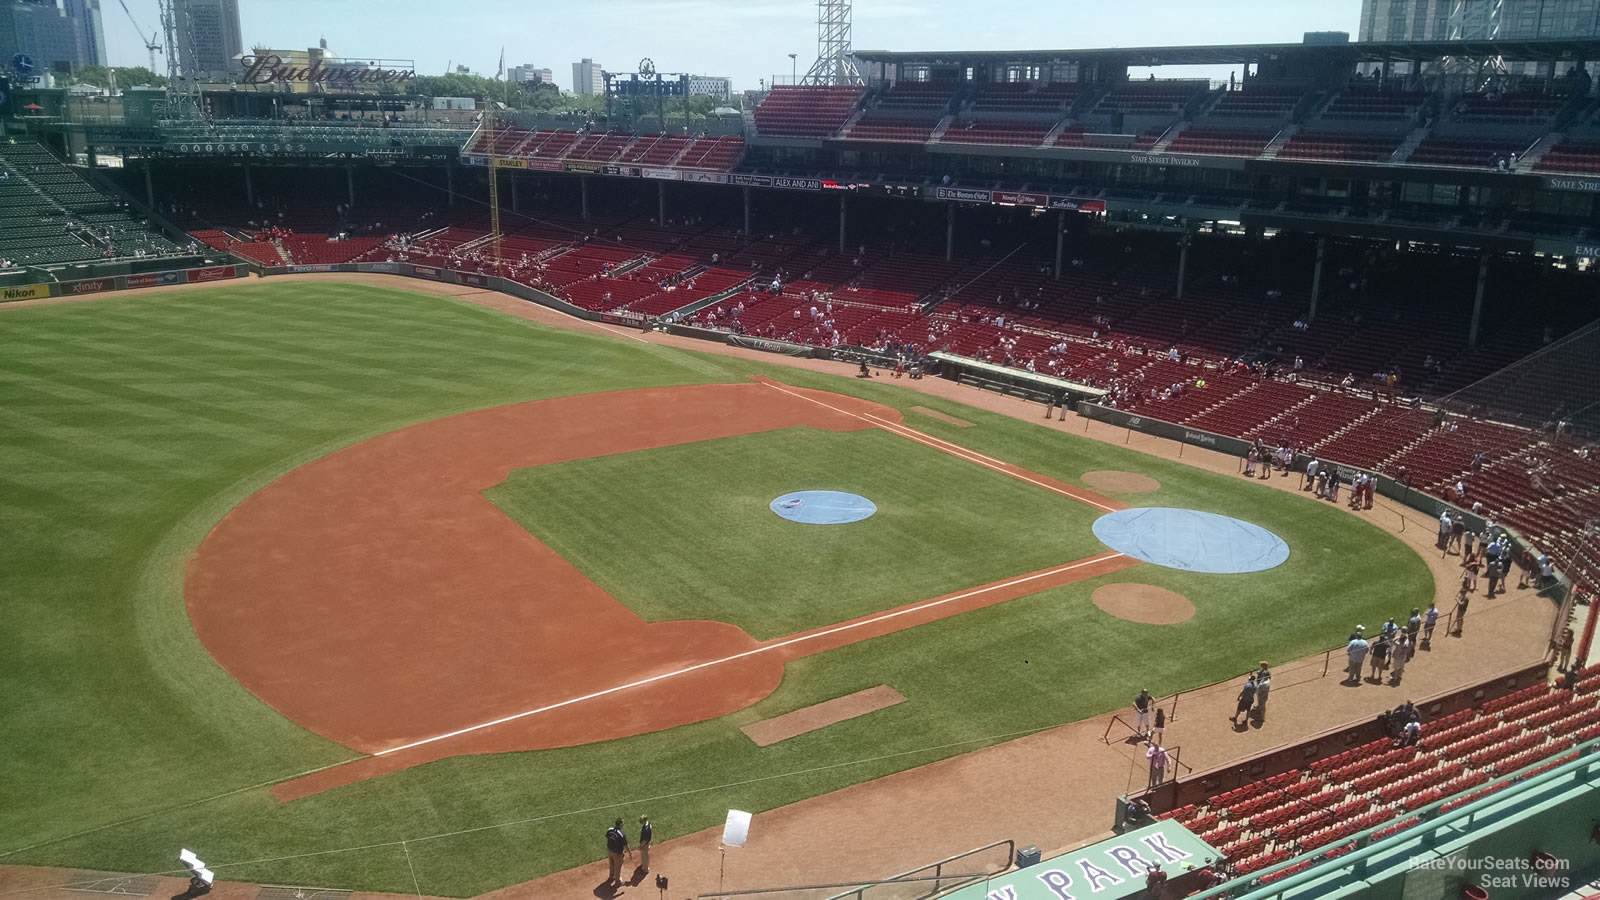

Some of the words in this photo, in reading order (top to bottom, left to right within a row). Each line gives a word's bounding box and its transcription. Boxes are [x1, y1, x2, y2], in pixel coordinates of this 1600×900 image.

[241, 55, 416, 89] Budweiser
[1131, 155, 1147, 163] STATE
[1148, 156, 1169, 164] STREET
[1170, 157, 1200, 166] PAVILION
[776, 178, 790, 186] ALEX
[792, 179, 806, 187] AND
[807, 180, 819, 189] ANI
[1551, 178, 1576, 189] STATE
[974, 192, 988, 200] Globe
[1053, 201, 1077, 209] Safelite
[72, 280, 103, 293] xfinity
[3, 288, 36, 299] Nikon
[1036, 831, 1193, 900] PARK
